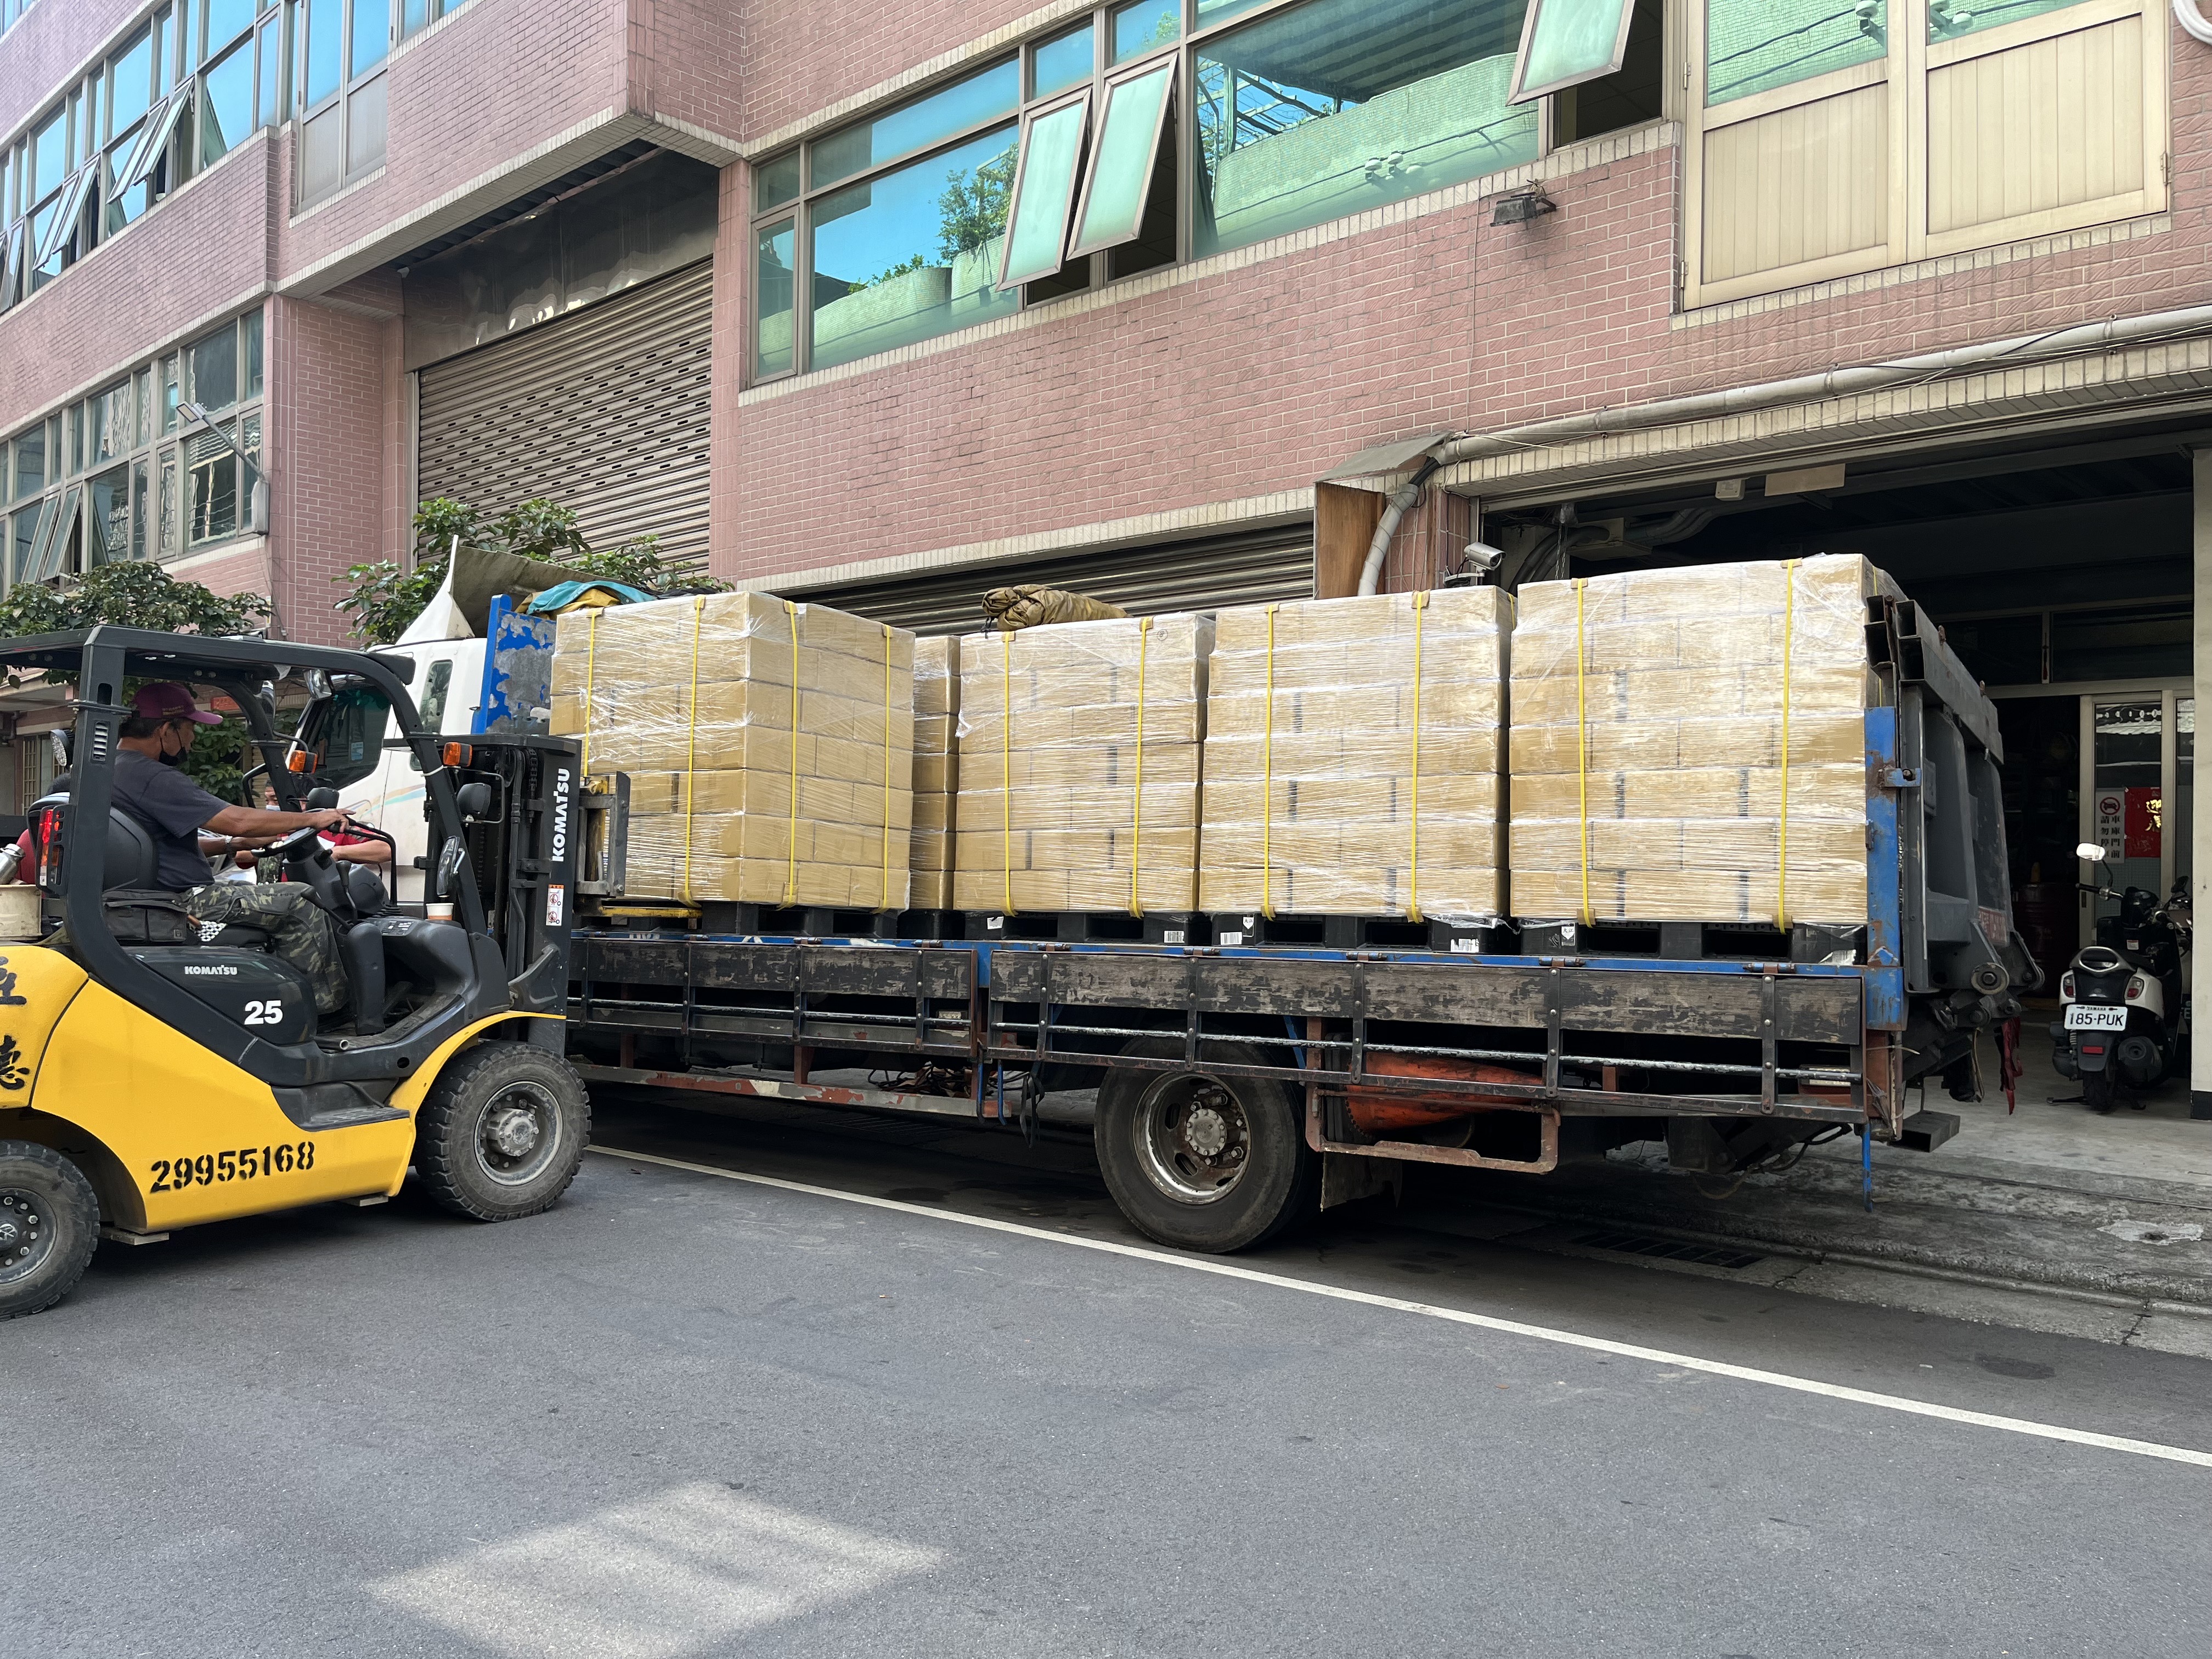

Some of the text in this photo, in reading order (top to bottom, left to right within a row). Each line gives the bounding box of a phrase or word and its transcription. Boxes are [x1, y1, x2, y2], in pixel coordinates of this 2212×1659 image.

[552, 768, 570, 862] KOMATSU
[2101, 815, 2109, 857] 請勿停
[2111, 815, 2120, 859] 車庫門前
[184, 964, 238, 975] KOMATSU
[244, 1000, 283, 1025] 25
[2070, 1013, 2124, 1026] 185-PUK
[149, 1141, 315, 1194] 29955168
